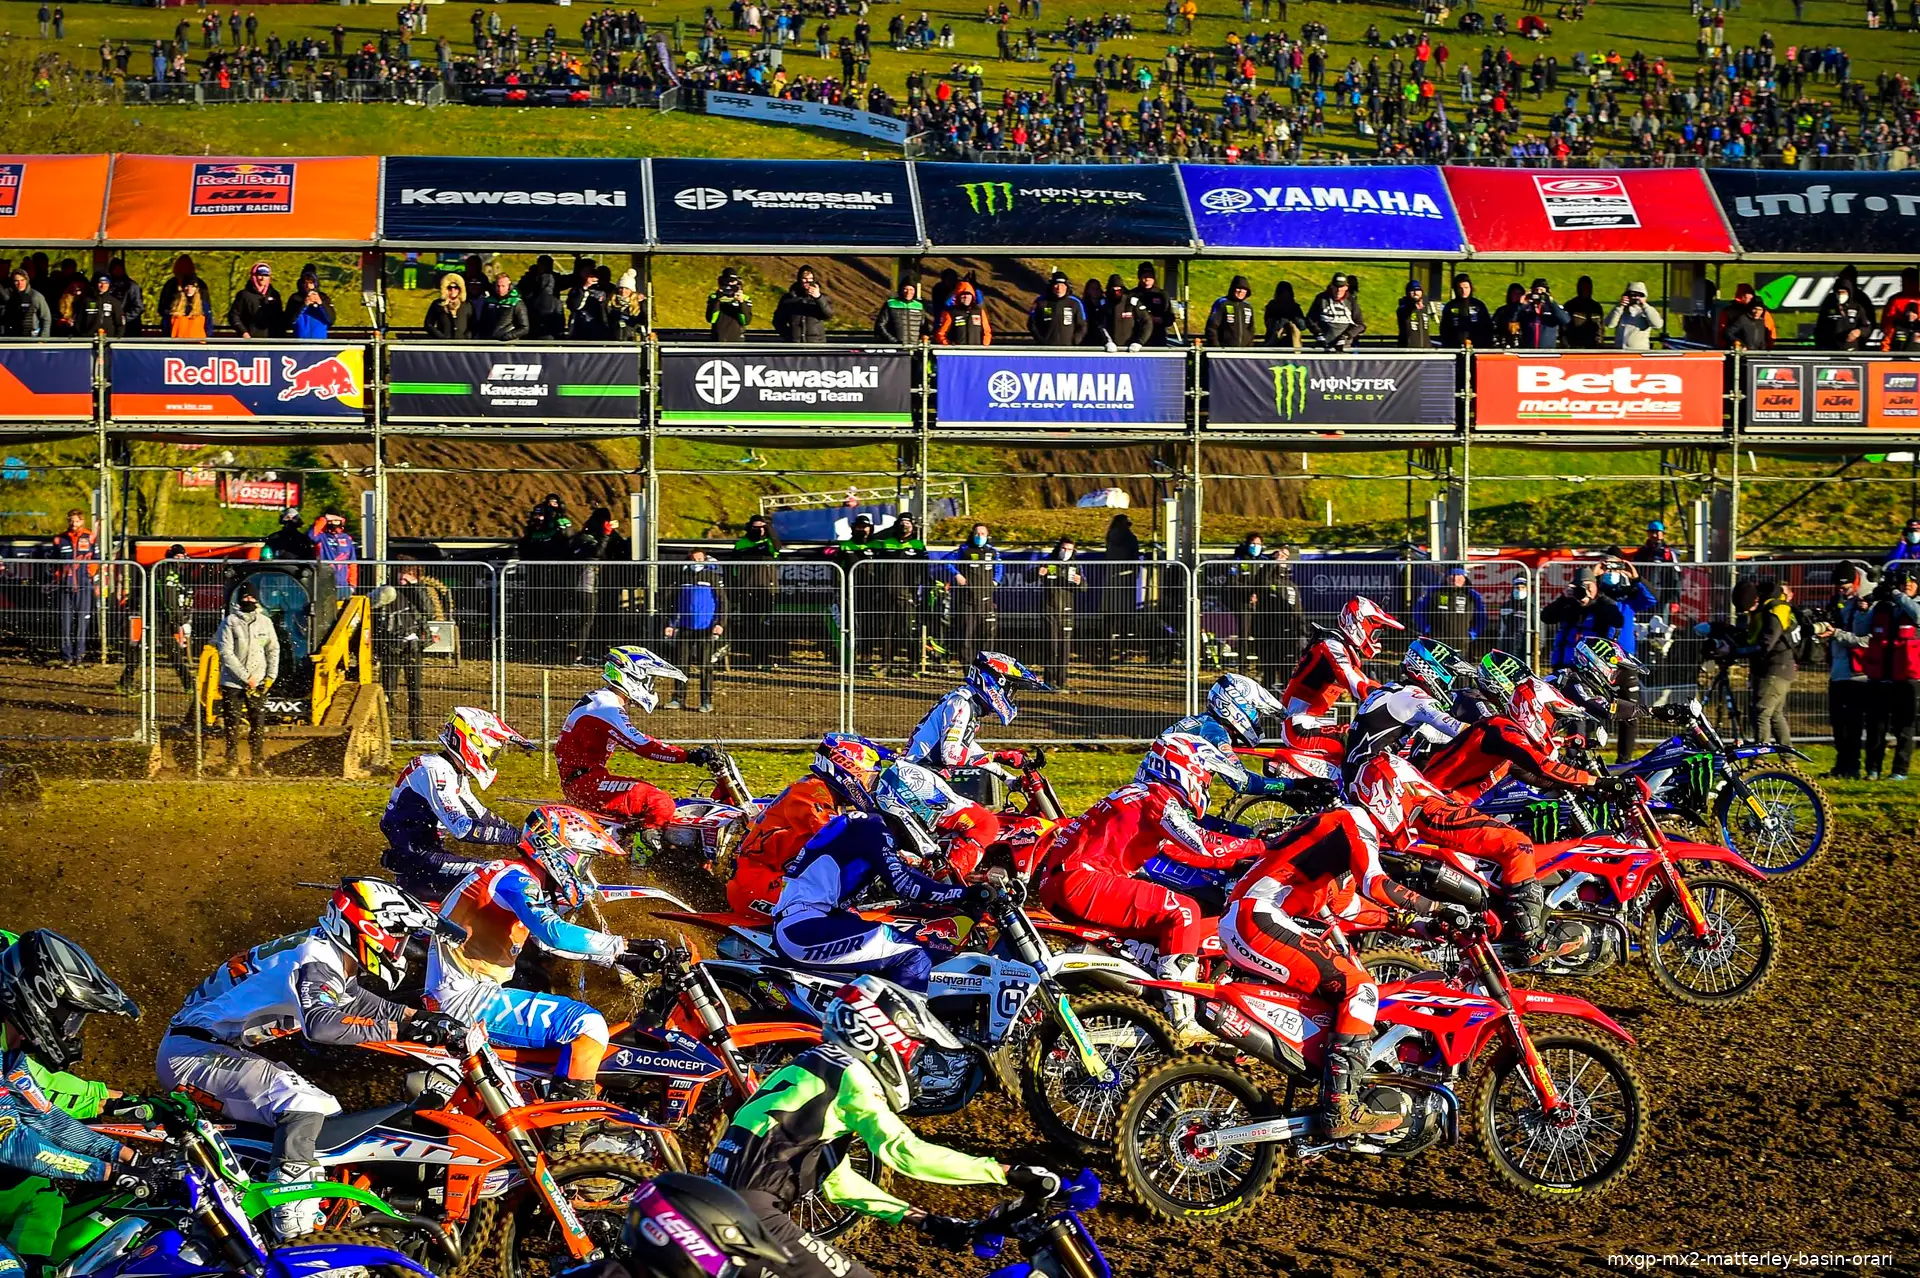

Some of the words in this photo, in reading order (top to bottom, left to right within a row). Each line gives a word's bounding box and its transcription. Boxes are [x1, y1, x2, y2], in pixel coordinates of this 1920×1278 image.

[197, 174, 243, 186] Red
[244, 174, 290, 186] Bull
[207, 189, 278, 200] KTM
[401, 188, 627, 207] Kawasaki
[732, 189, 893, 204] Kawasaki
[1019, 187, 1147, 201] MONSTER
[1253, 187, 1441, 215] YAMAHA
[194, 205, 242, 213] FACTORY
[246, 204, 289, 212] RACING
[752, 201, 820, 210] Racing
[822, 202, 876, 210] Team
[1205, 206, 1329, 215] FACTORY
[1343, 207, 1444, 219] RACING
[164, 357, 217, 385] Red
[219, 357, 271, 385] Bull
[744, 365, 878, 388] Kawasaki
[1310, 376, 1397, 392] MONSTER
[1517, 365, 1683, 394] Beta
[480, 383, 549, 396] Kawasaki
[1021, 373, 1134, 401] YAMAHA
[759, 389, 817, 403] Racing
[817, 389, 864, 402] Team
[1763, 395, 1794, 406] KTM
[1823, 395, 1854, 406] KTM
[1518, 397, 1682, 418] motorcycles
[598, 780, 639, 793] SHOT
[438, 861, 479, 874] SHO
[803, 935, 865, 962] THOR
[1230, 936, 1286, 977] HONDA
[929, 974, 983, 987] usqvarna
[1258, 989, 1310, 1001] HONDA
[636, 1054, 652, 1065] 4D
[653, 1056, 707, 1072] CONCEPT
[103, 1126, 136, 1135] MAXXIS
[450, 1173, 469, 1181] KTM
[279, 1182, 314, 1193] MOTOREX
[550, 1192, 579, 1233] MOTOREX
[1185, 1195, 1244, 1217] PIRELLI
